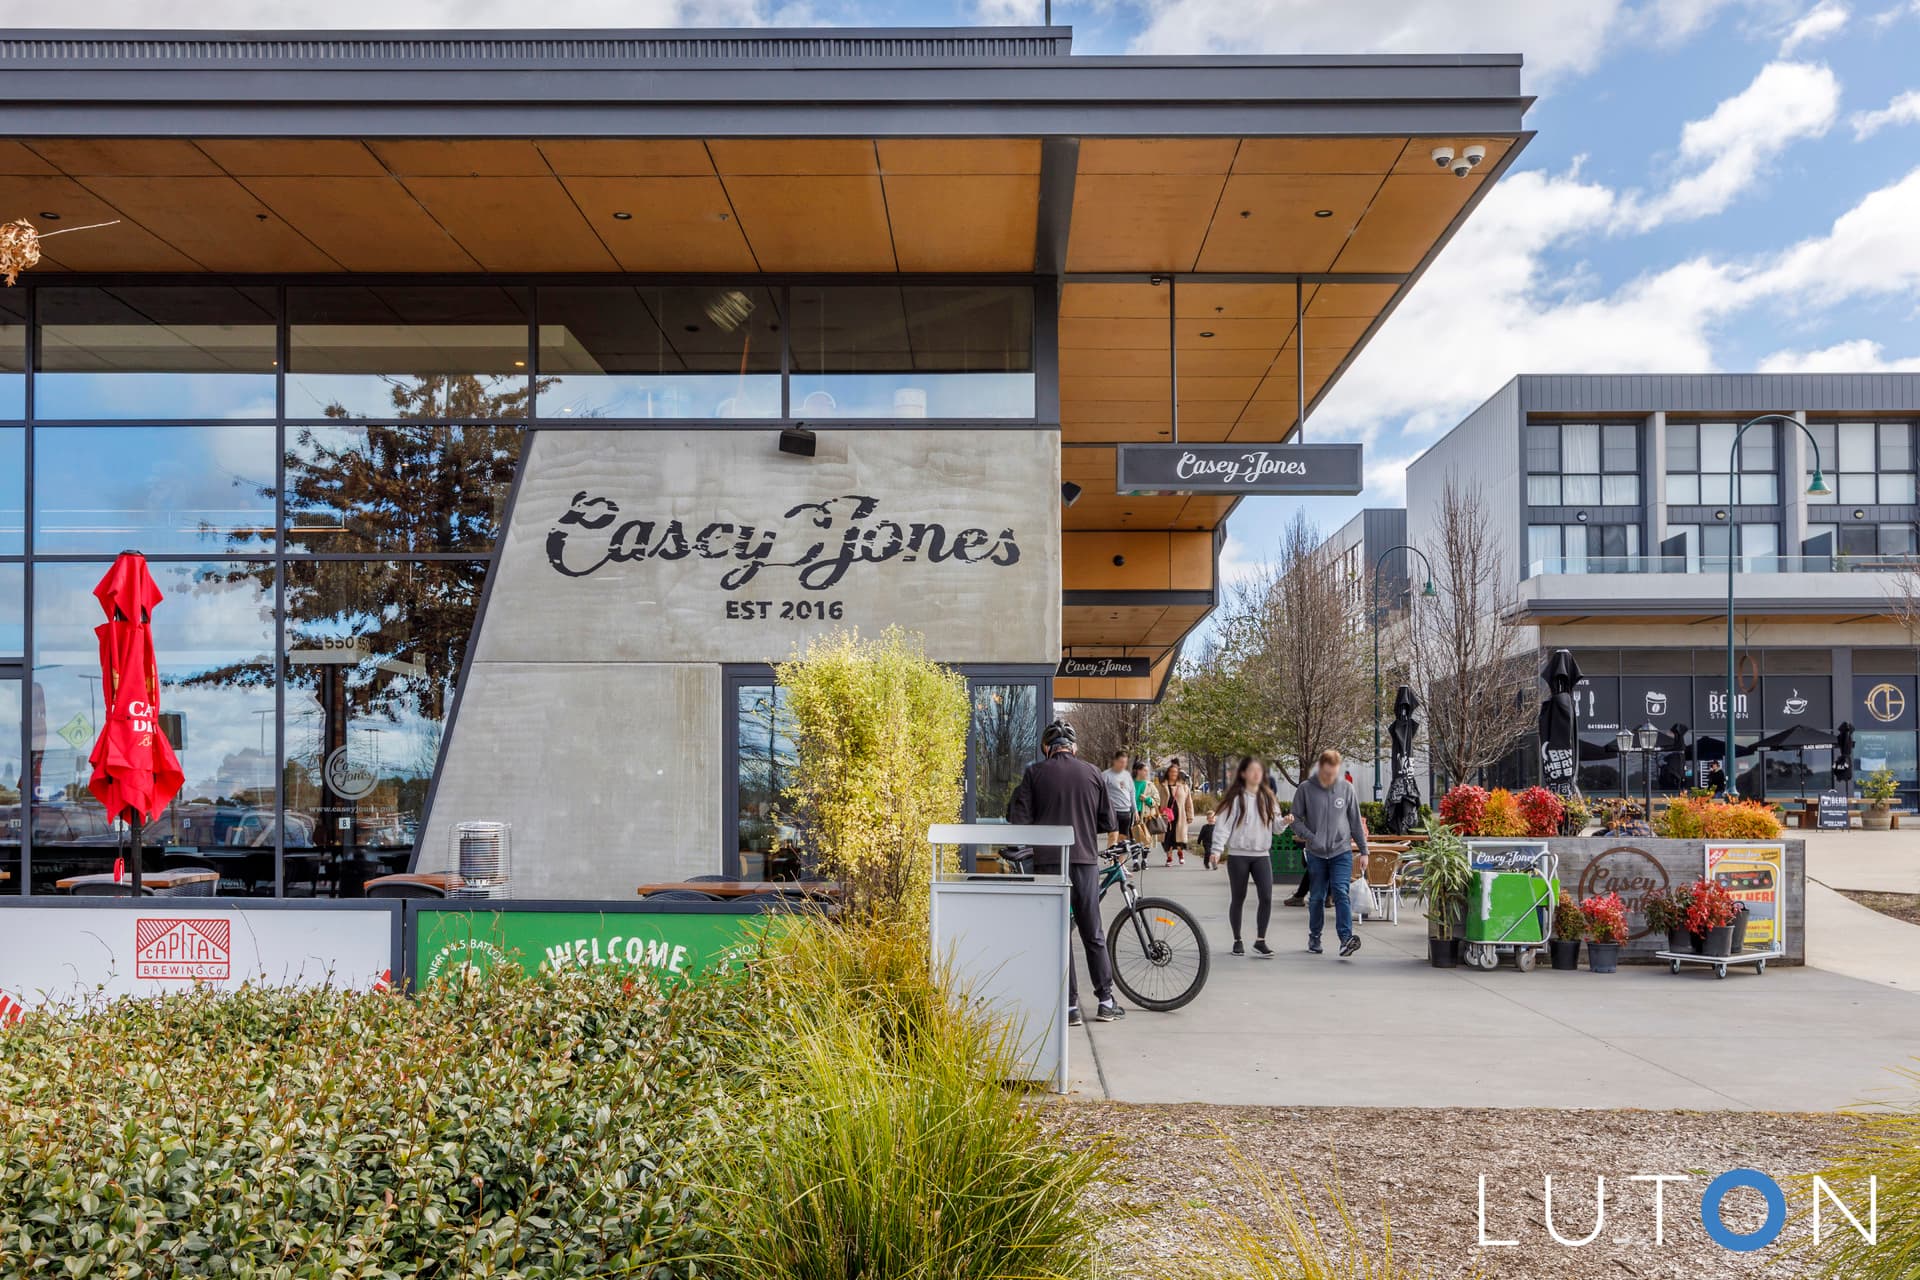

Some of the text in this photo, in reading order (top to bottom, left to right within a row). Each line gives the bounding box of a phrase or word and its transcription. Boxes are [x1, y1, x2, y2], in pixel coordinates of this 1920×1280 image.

[1176, 451, 1307, 483] Casey Jones
[546, 490, 1021, 591] Casey Jones
[725, 600, 843, 621] EST 2016
[1065, 659, 1132, 676] Casey Jones
[1709, 694, 1747, 713] BEN
[1710, 712, 1749, 720] STAON
[146, 924, 222, 960] CAPITAL
[545, 936, 688, 974] WELCOME
[143, 965, 204, 975] BREWING
